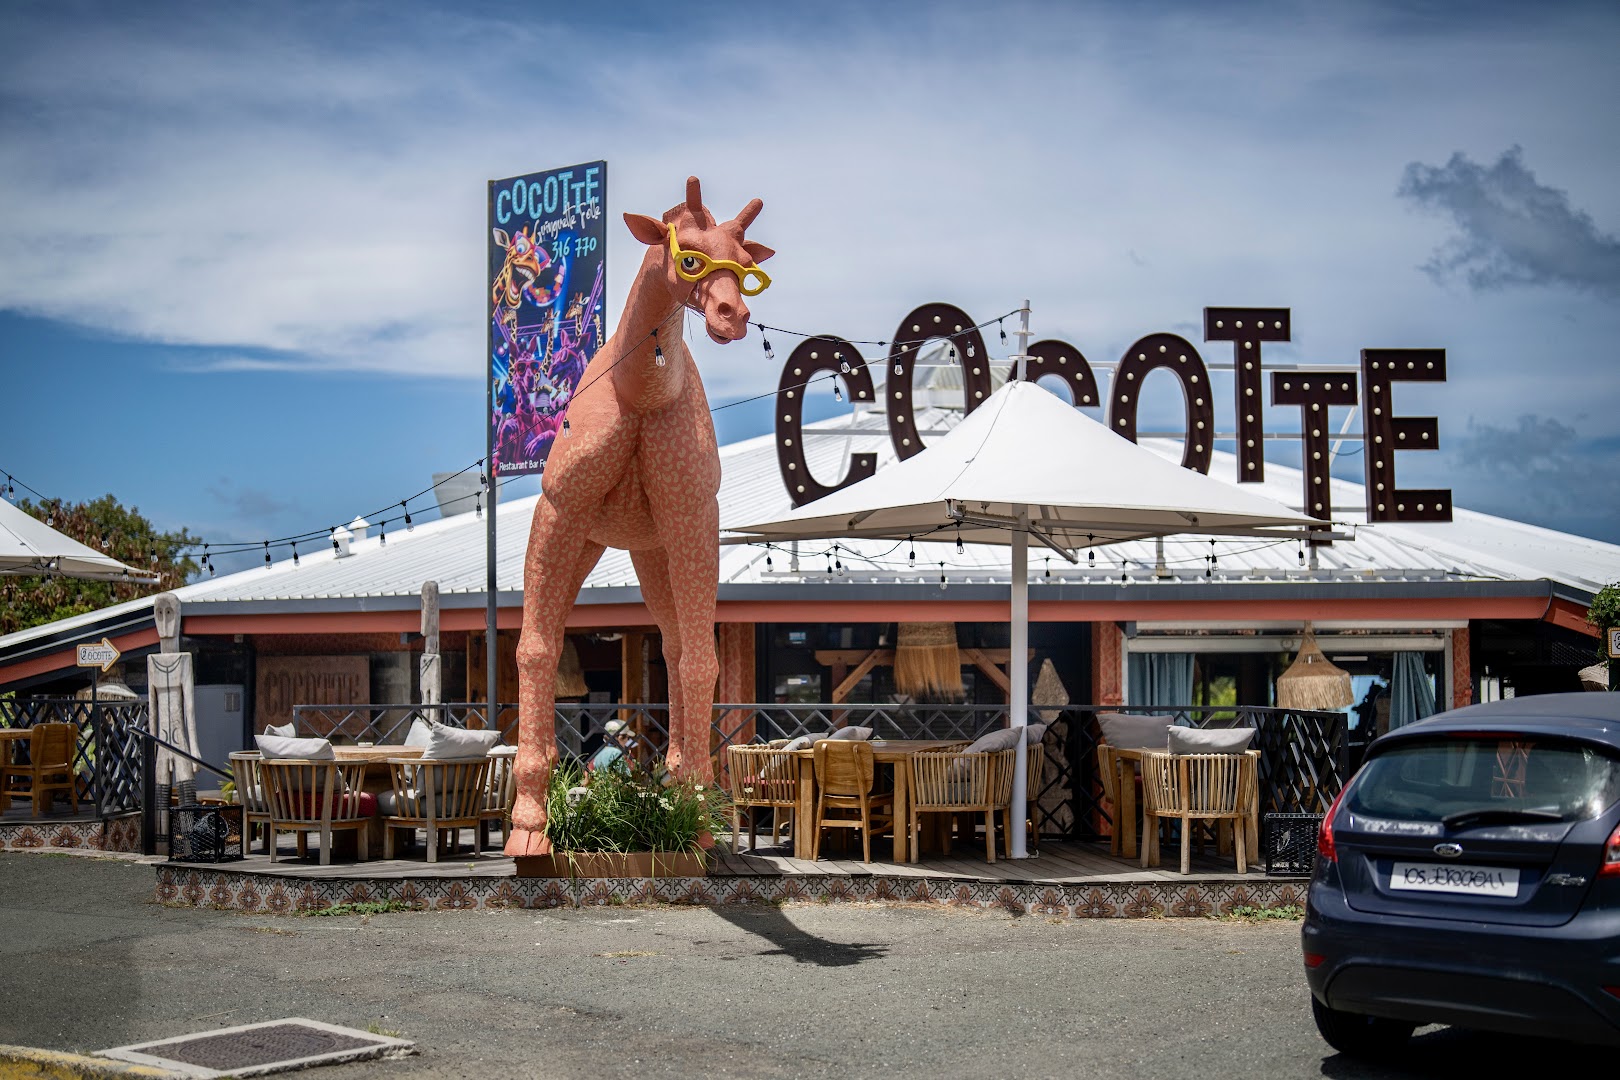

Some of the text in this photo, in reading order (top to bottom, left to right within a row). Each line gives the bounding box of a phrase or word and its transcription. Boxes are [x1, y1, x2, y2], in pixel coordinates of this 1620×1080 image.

[496, 167, 600, 224] COCOTTE
[579, 196, 601, 229] Folle
[552, 236, 597, 263] 316 770
[499, 460, 528, 471] Restaurant
[529, 459, 539, 469] Bar
[81, 647, 112, 660] COCOTTE
